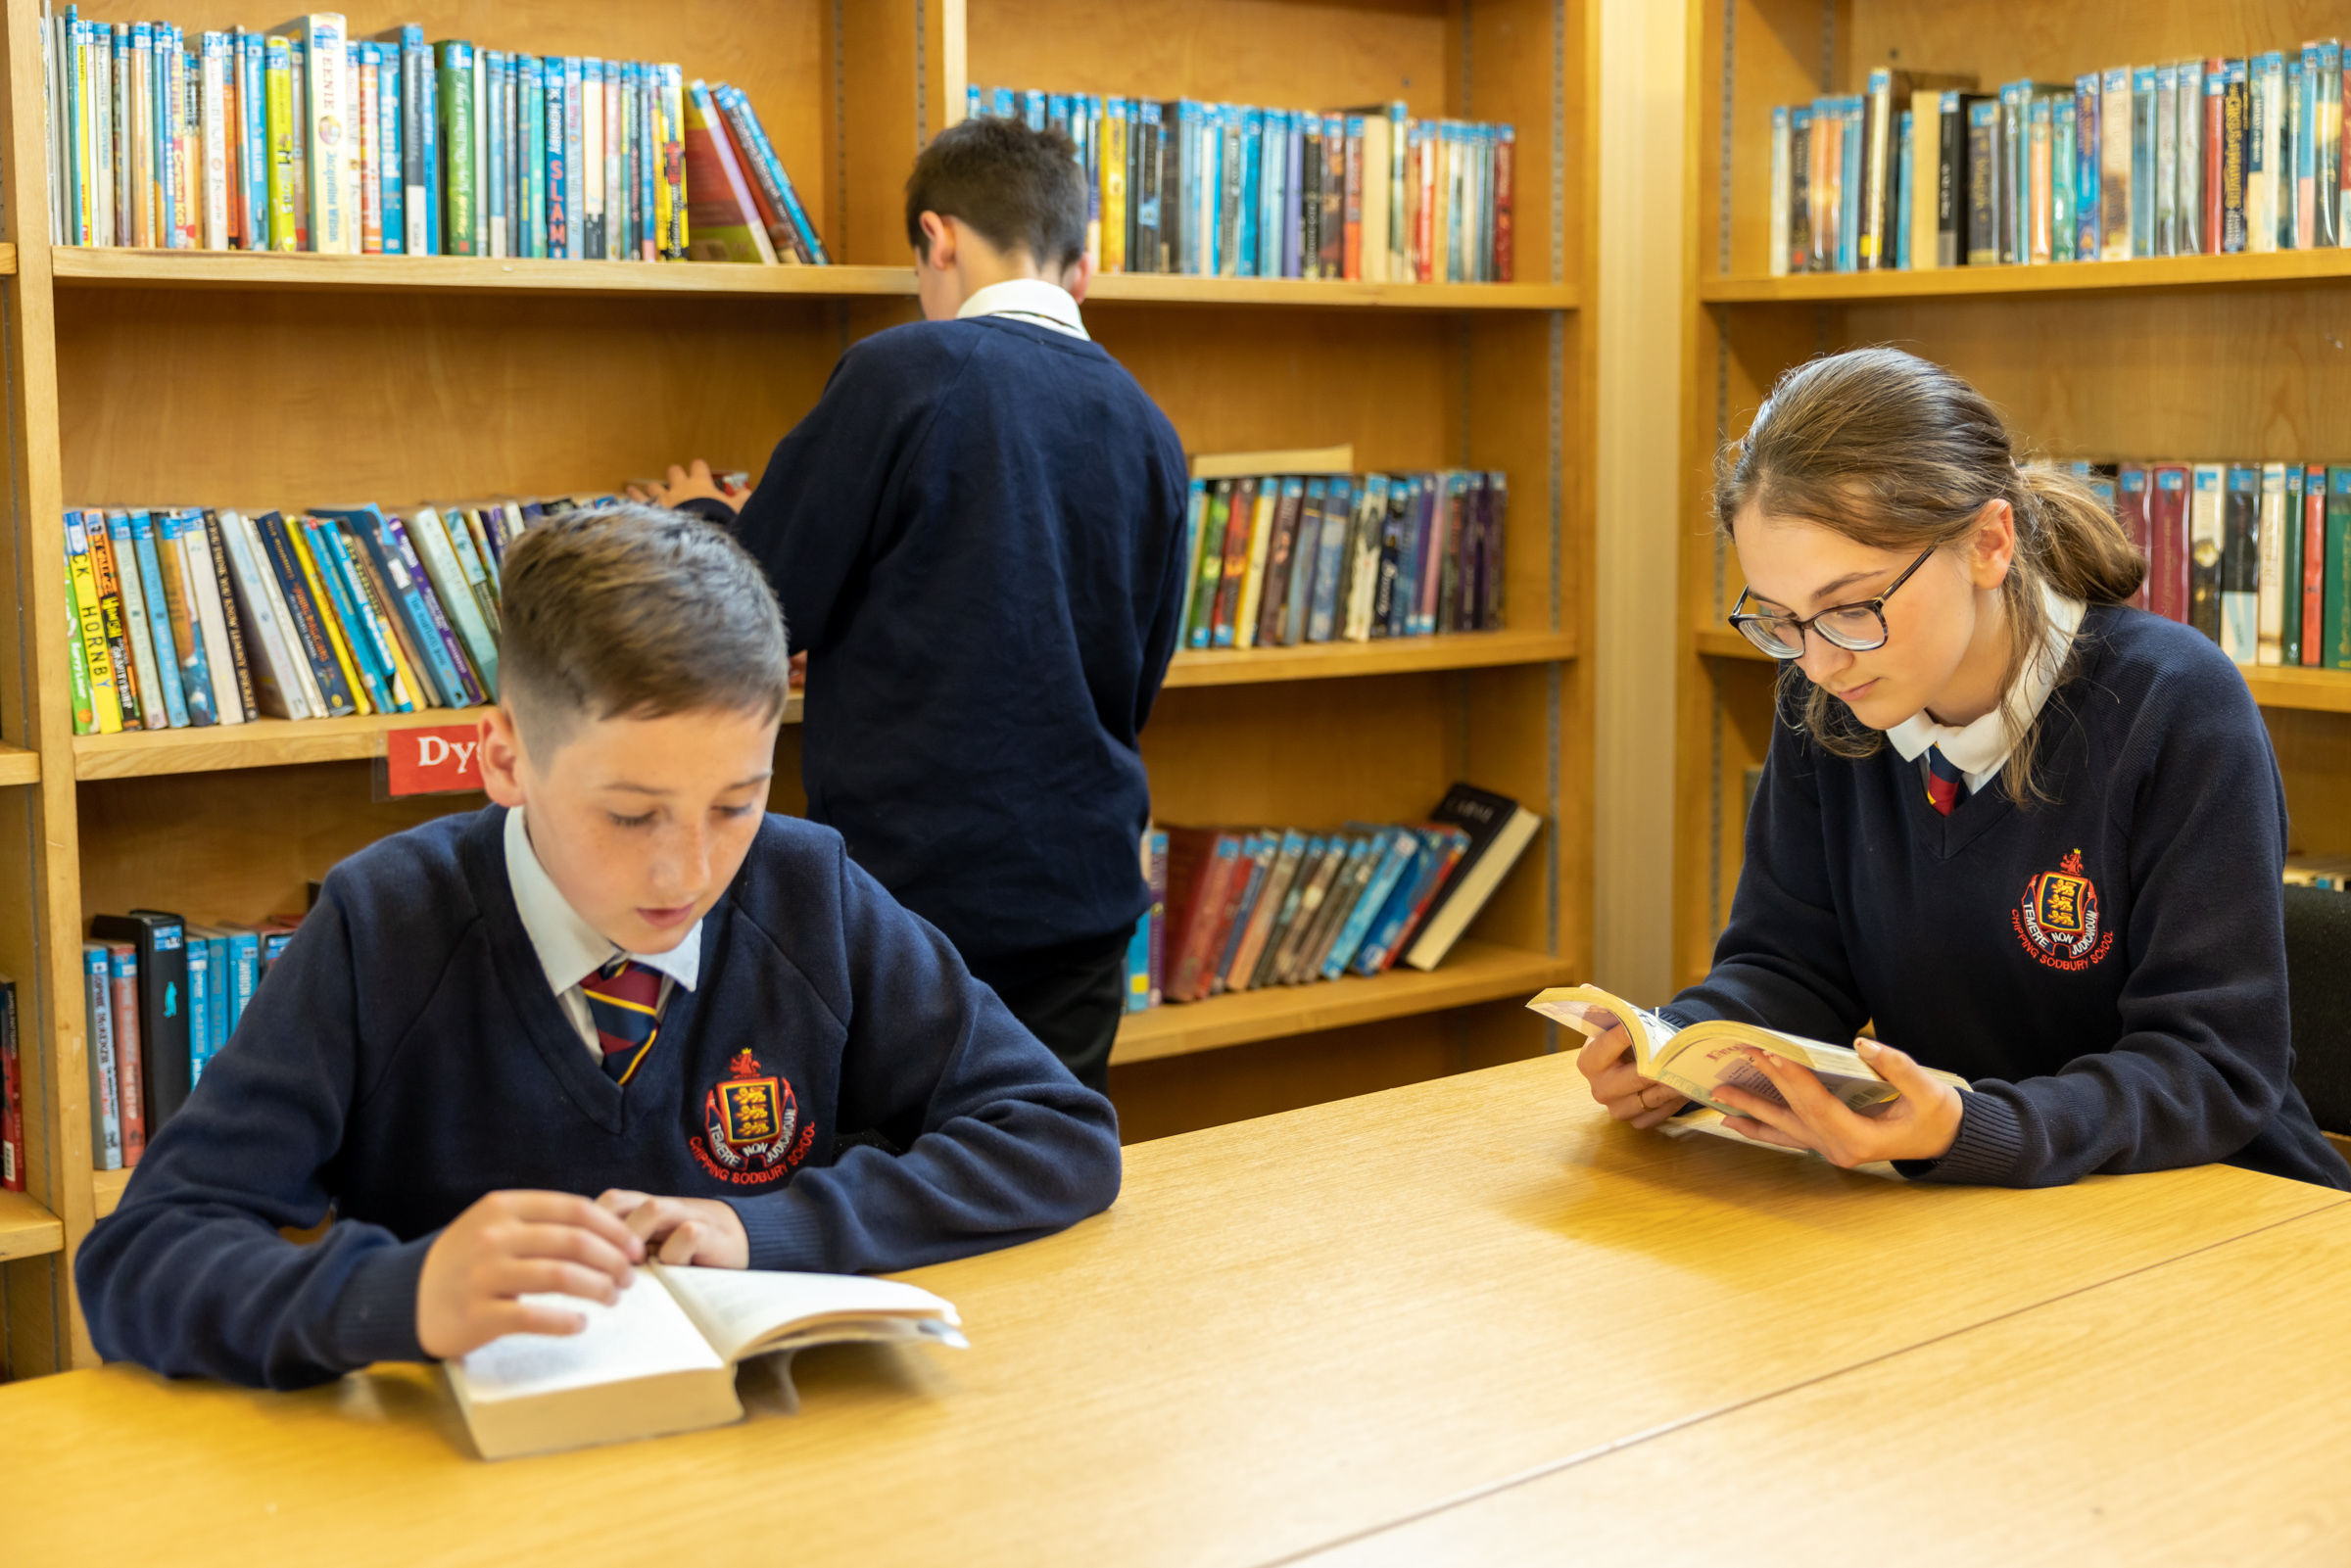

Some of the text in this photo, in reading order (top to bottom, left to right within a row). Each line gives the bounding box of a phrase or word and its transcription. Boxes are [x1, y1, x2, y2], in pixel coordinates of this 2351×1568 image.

[322, 51, 335, 110] EENIE
[382, 96, 400, 179] framed
[548, 103, 563, 155] HORNBY
[323, 150, 339, 243] Jacqueline Wilson
[551, 160, 566, 245] SLAM
[209, 527, 221, 545] YOU
[96, 549, 114, 595] WALLACE
[212, 546, 226, 576] THINK
[218, 578, 231, 596] YOU
[294, 587, 312, 614] YOUNG
[101, 595, 122, 639] HAMISH
[223, 597, 238, 628] KNOW
[81, 605, 111, 689] HORNBY
[239, 669, 256, 708] SNICKET
[2011, 909, 2114, 972] CHIPPING SODBURY SCHOOL
[2023, 901, 2050, 949] TEMERE
[2050, 931, 2075, 945] NON
[689, 1120, 816, 1185] CHIPPING SODBURY SCHOOL
[709, 1122, 742, 1167] TEMERE
[743, 1141, 769, 1158] NON
